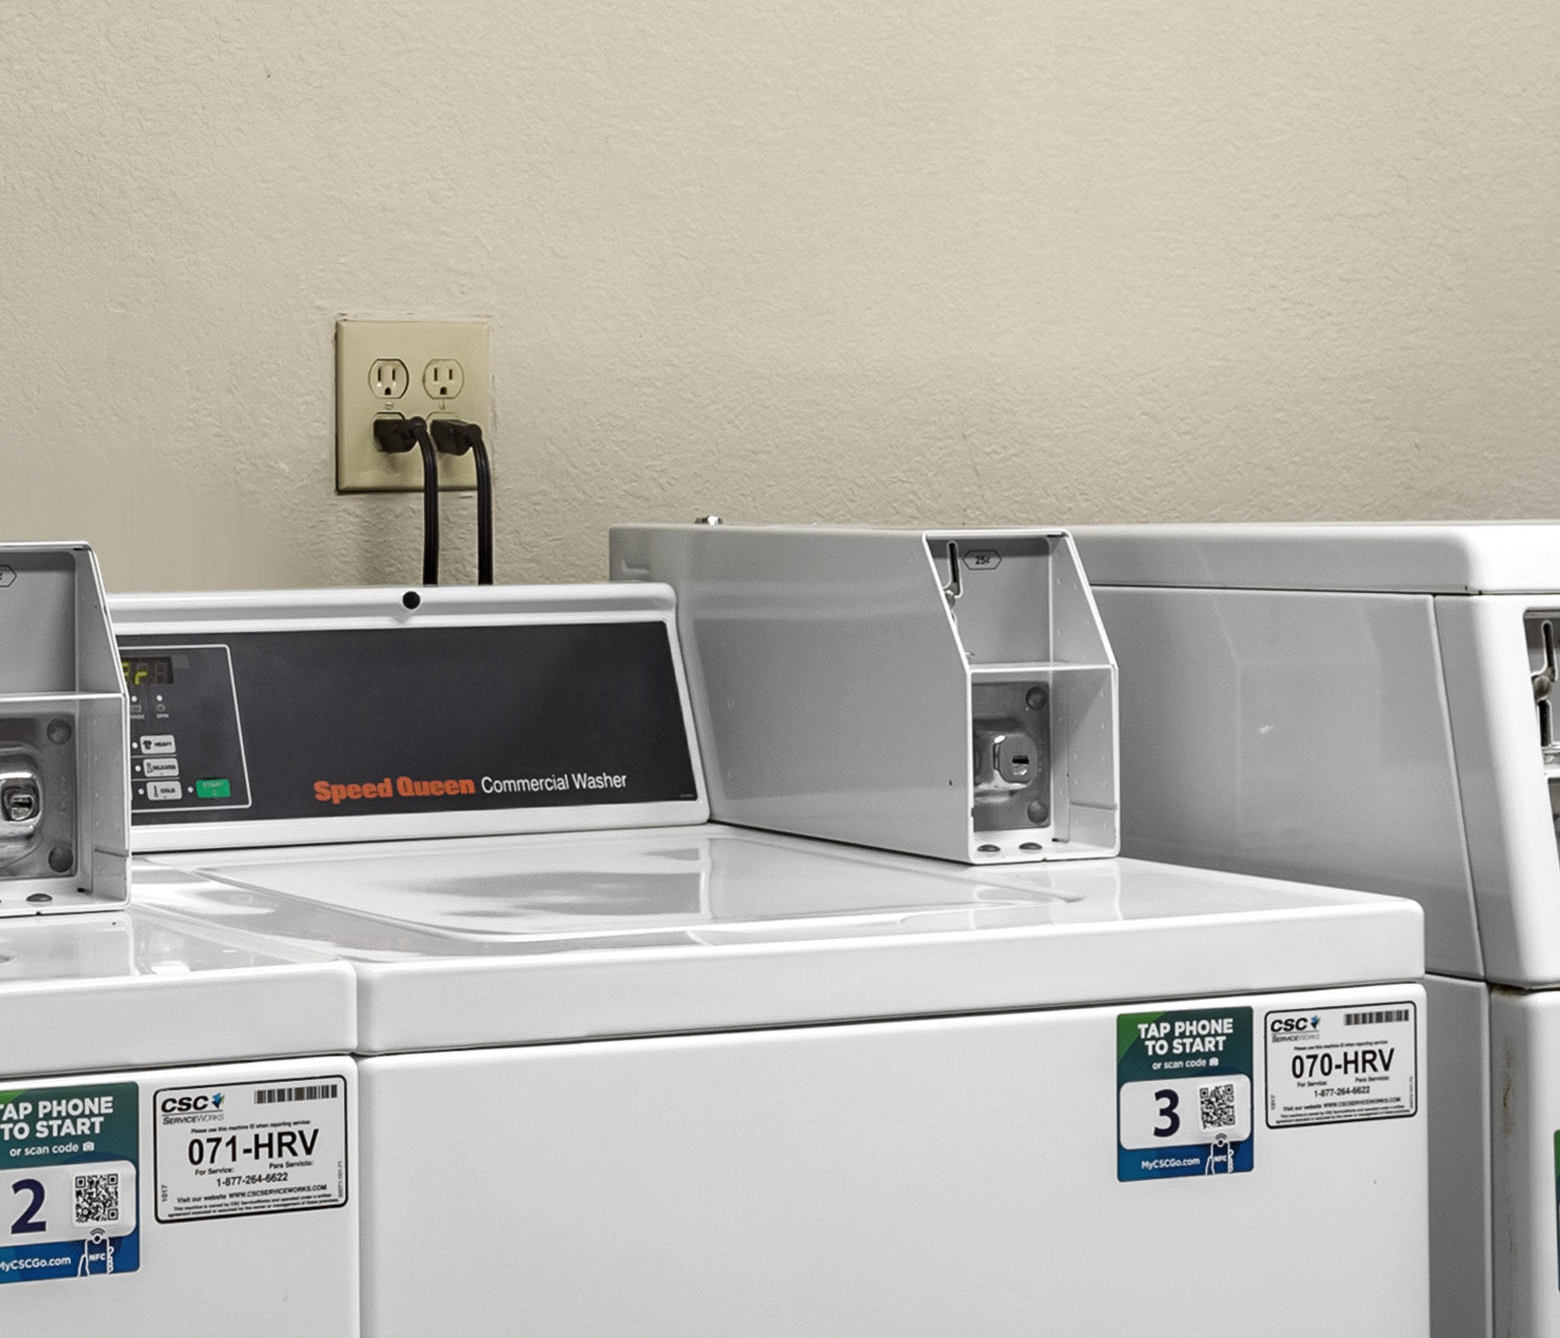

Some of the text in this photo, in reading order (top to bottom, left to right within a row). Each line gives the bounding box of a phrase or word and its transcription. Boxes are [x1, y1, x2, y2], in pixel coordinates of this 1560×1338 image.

[313, 770, 628, 806] Speed Queen Commercial Washer
[1137, 1018, 1234, 1039] TAP PHONE
[1270, 1016, 1308, 1033] CSC
[1144, 1035, 1227, 1056] TO START
[1291, 1047, 1395, 1080] 070-HRV
[38, 1096, 114, 1118] PHONE
[160, 1094, 209, 1113] CSC
[1152, 1088, 1180, 1138] 3
[0, 1116, 105, 1141] TO START
[187, 1128, 320, 1166] 071-HRV
[1141, 1156, 1201, 1171] MyCSCGo.com
[215, 1171, 289, 1188] 1-877-264-6622
[9, 1178, 48, 1235] 2
